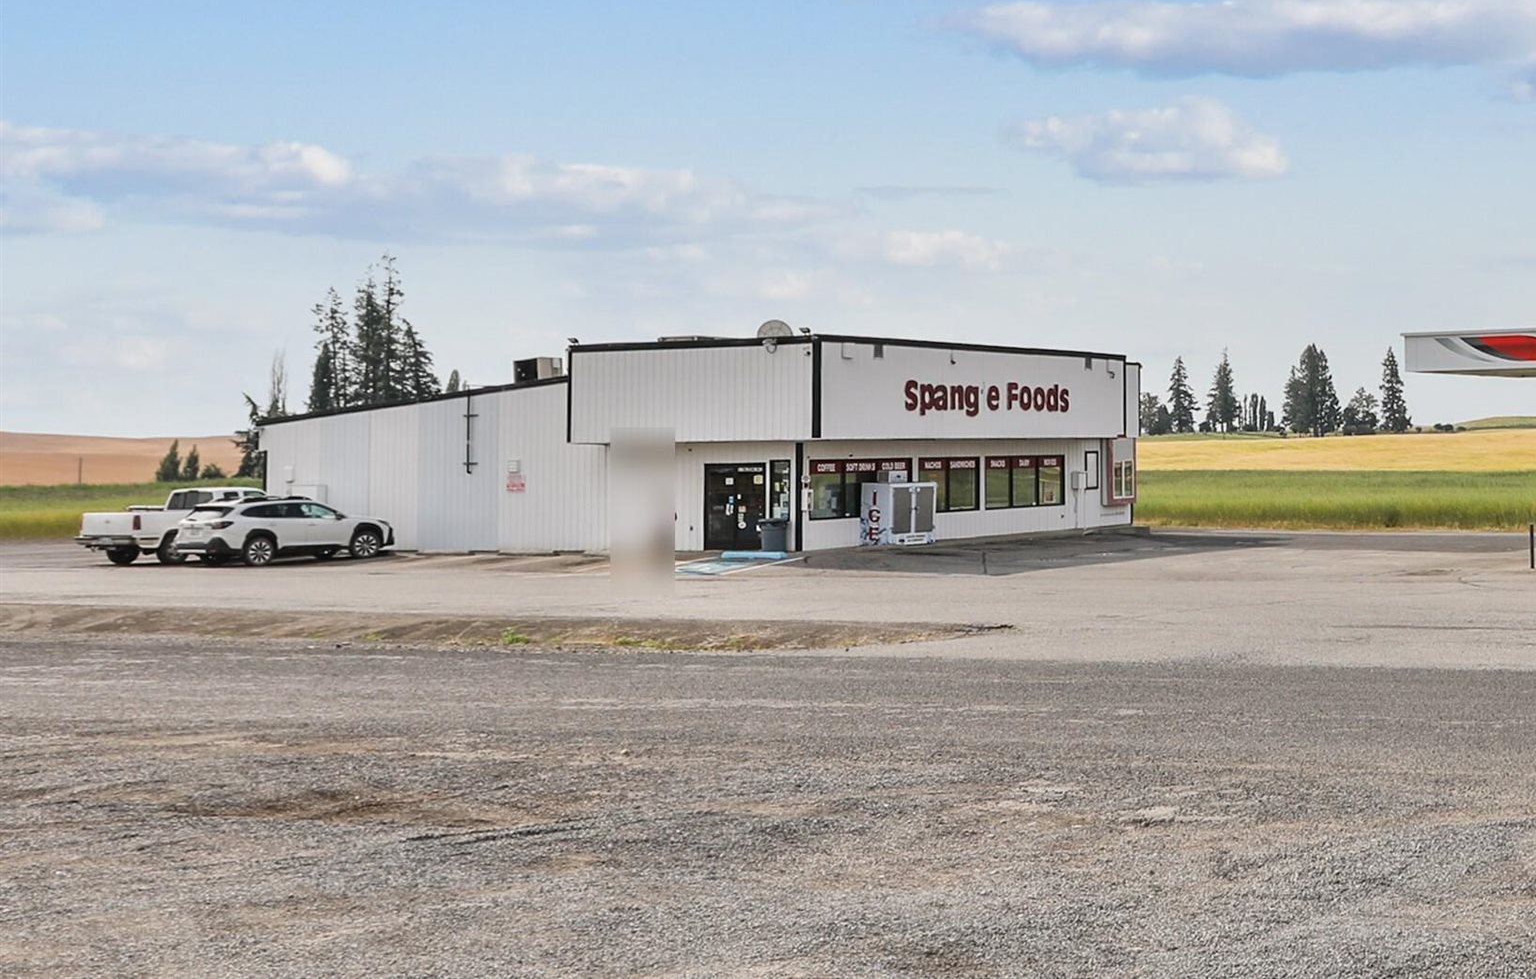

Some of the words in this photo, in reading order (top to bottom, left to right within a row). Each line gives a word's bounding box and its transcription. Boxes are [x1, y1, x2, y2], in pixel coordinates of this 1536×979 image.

[904, 380, 1000, 417] Spange
[1007, 382, 1070, 413] Foods
[817, 463, 836, 472] COFFEE
[868, 491, 881, 541] ICE
